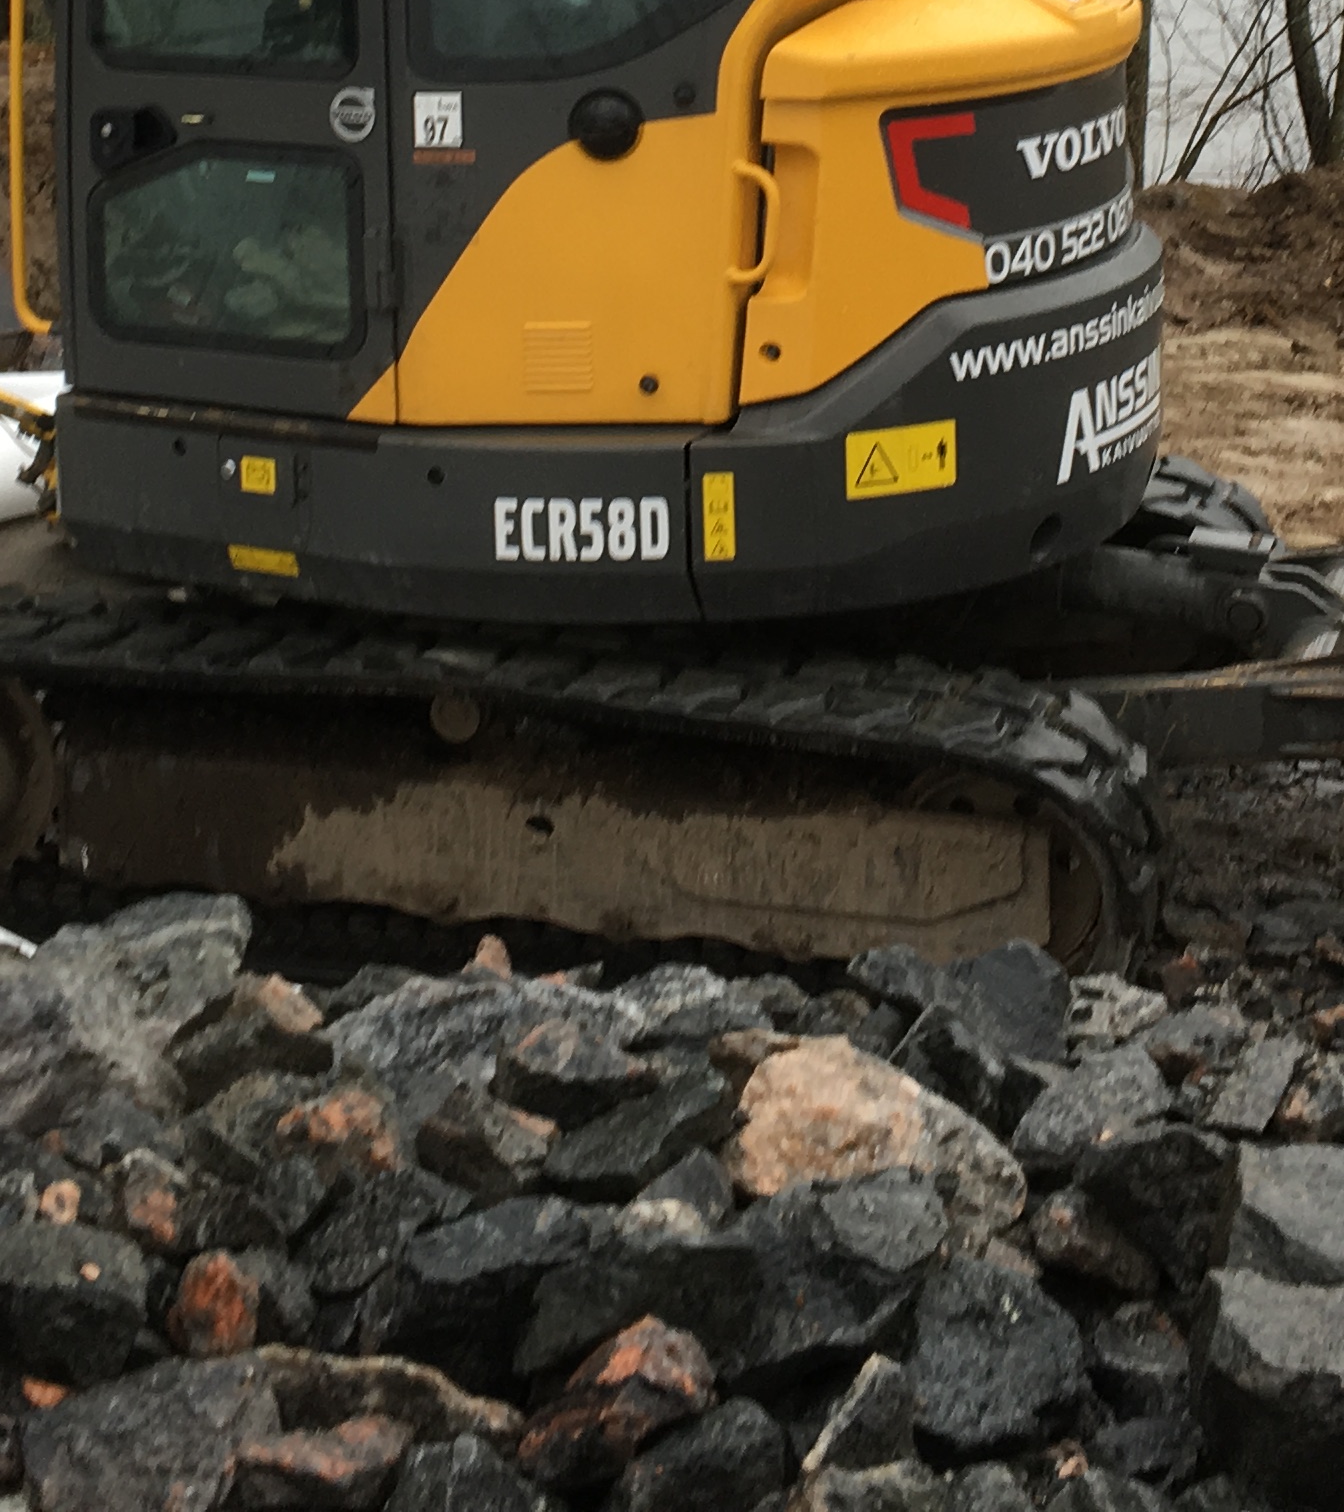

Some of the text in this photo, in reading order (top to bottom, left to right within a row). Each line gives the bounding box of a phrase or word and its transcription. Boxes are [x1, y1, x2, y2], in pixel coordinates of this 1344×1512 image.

[423, 115, 449, 146] 97
[1016, 103, 1127, 180] VOLVO
[985, 229, 1056, 285] 040
[1061, 209, 1106, 266] 522
[494, 495, 670, 562] ECR58D
